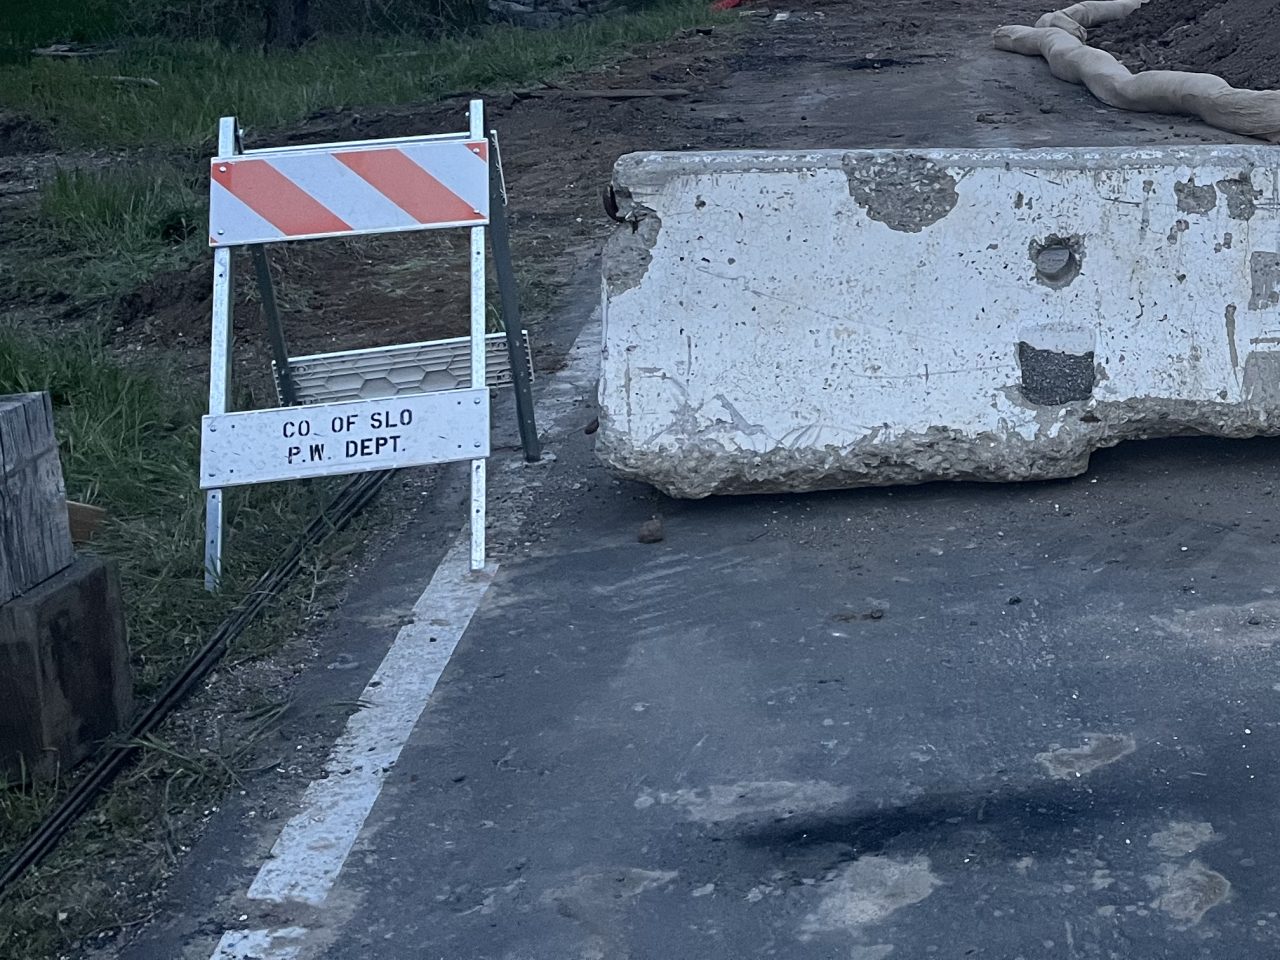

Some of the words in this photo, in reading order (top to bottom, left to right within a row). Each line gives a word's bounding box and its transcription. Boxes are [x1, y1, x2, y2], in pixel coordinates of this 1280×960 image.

[331, 414, 359, 433] OF
[370, 408, 413, 429] SLO
[287, 443, 332, 464] P.W.
[345, 435, 406, 458] DEPT.
